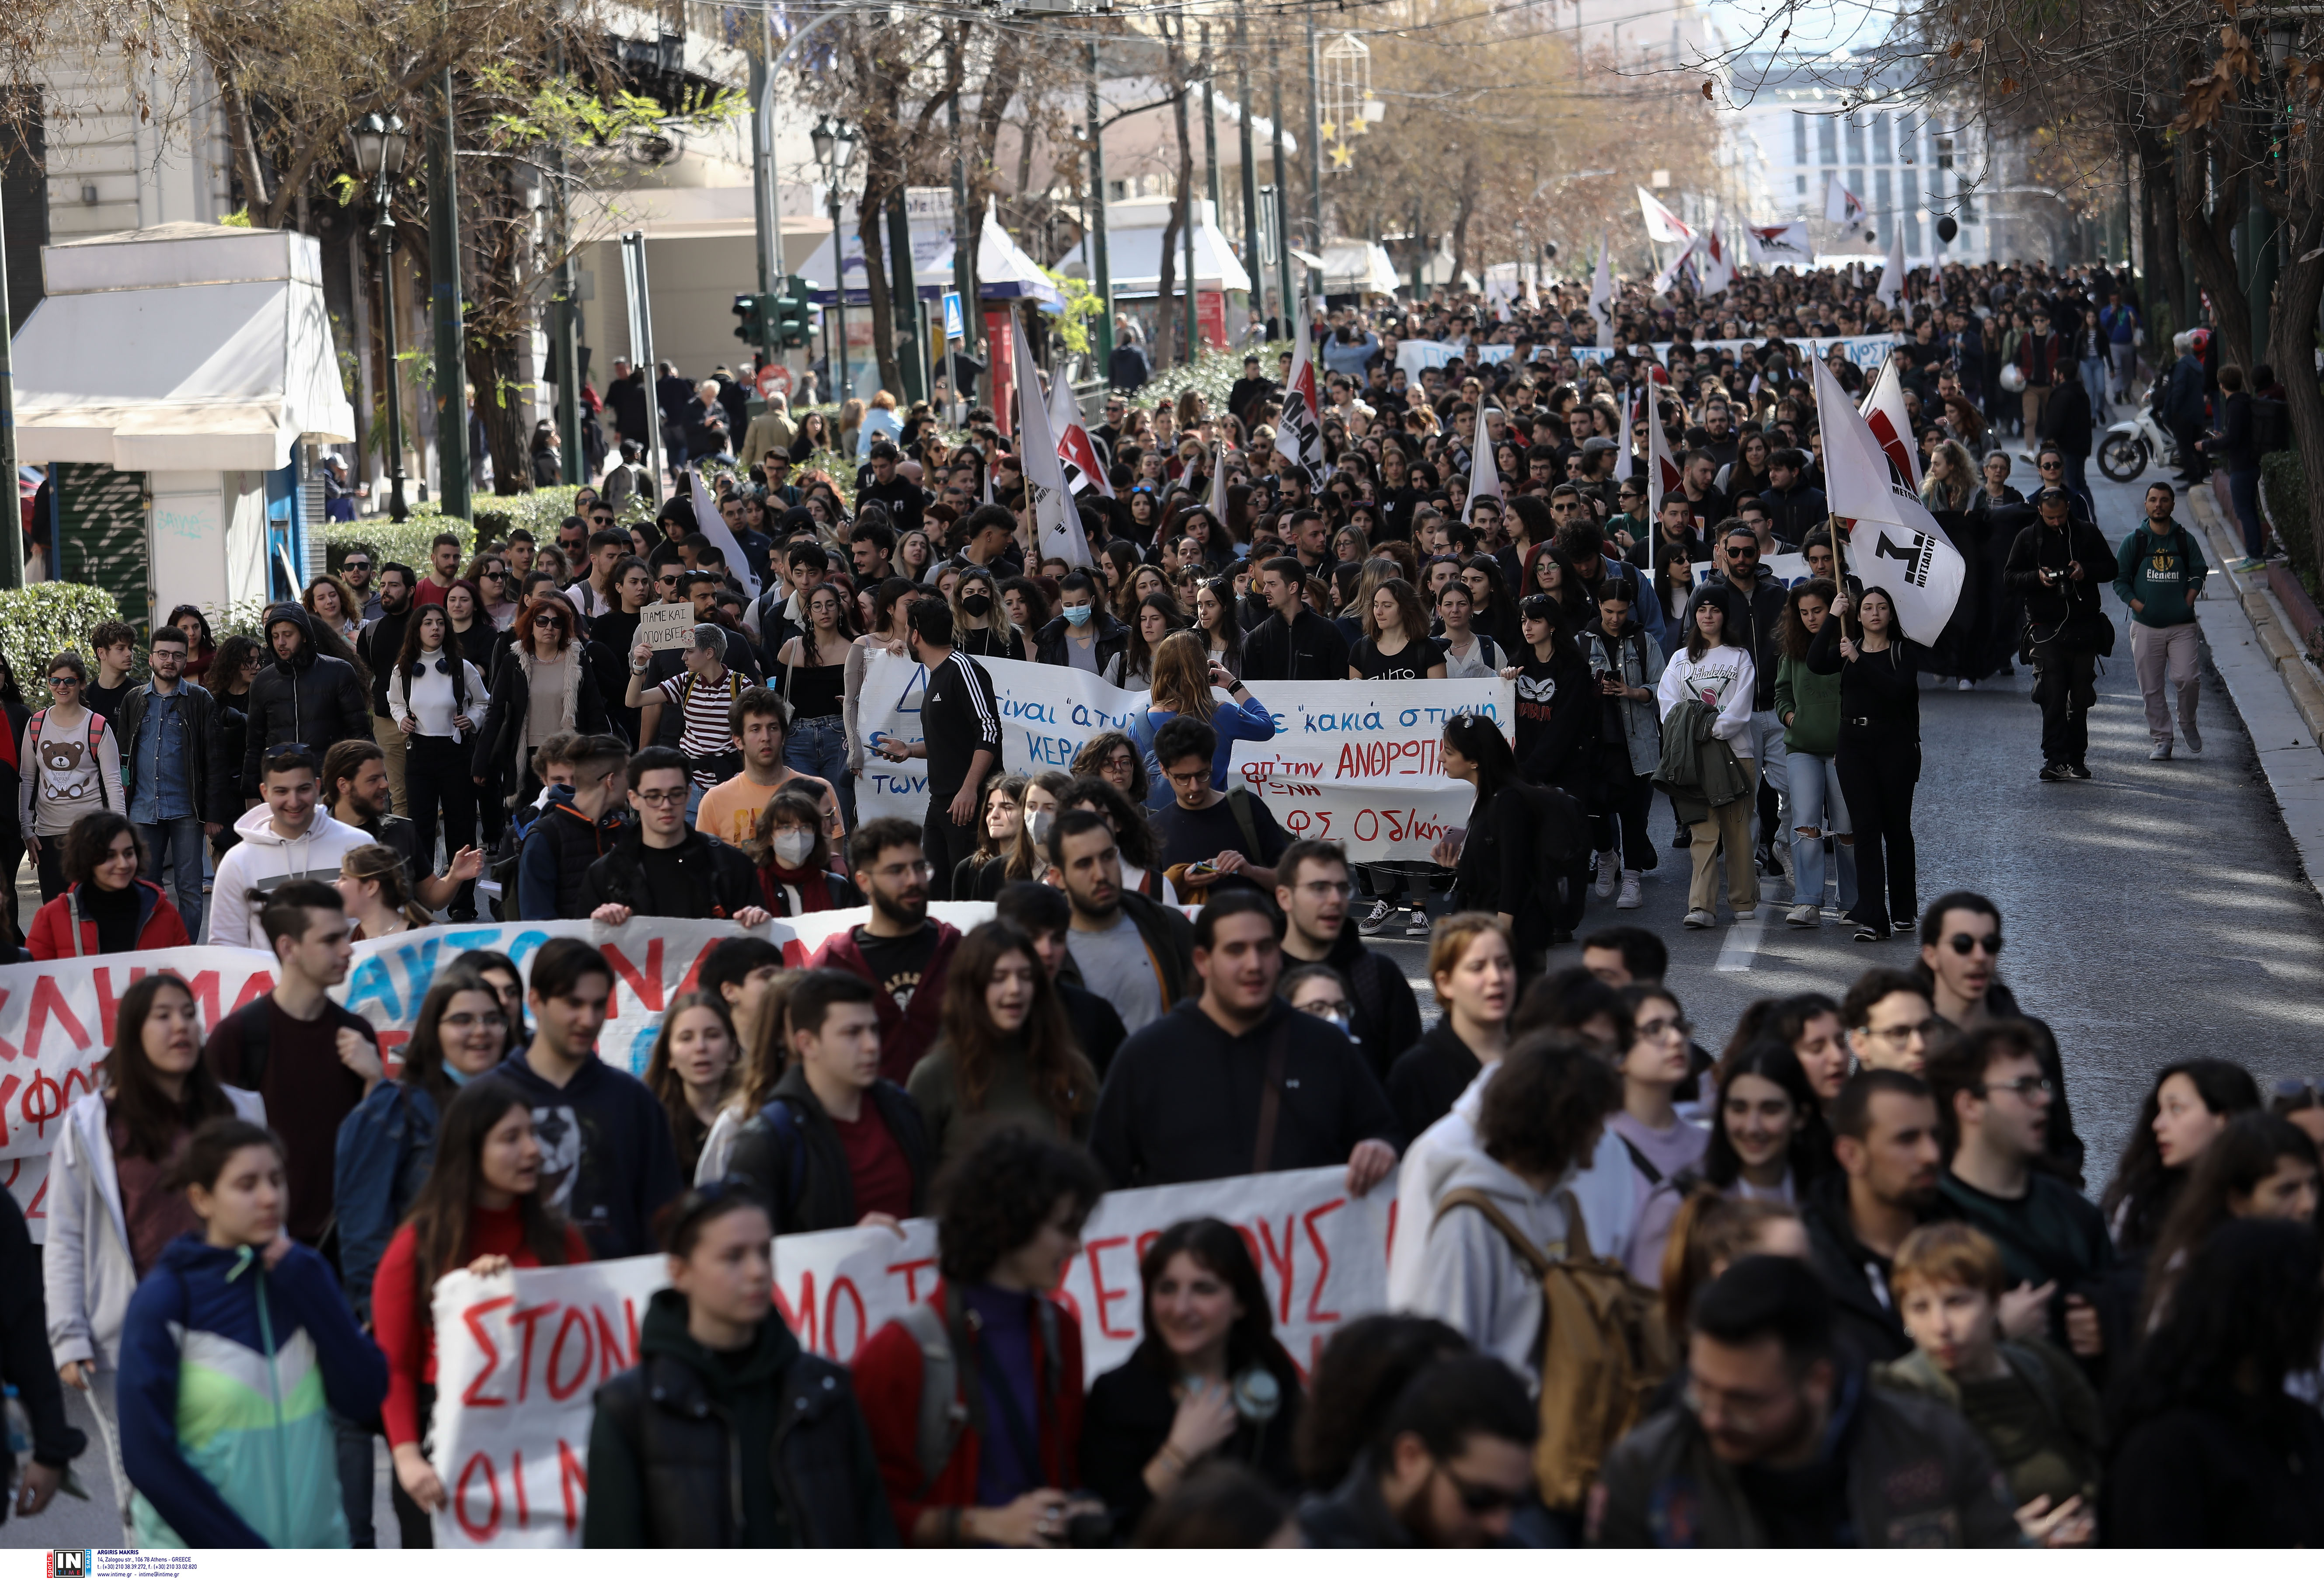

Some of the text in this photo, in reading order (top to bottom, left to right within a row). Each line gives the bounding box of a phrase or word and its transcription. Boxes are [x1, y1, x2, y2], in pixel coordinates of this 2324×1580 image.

[1892, 485, 1922, 506] ΜΕΤΩΠΟ
[2146, 569, 2179, 580] Element
[643, 609, 686, 623] ΠΑΜΕ ΚΑΙ
[643, 626, 684, 644] ΟΠΟΥ ΒΓΕΙ
[995, 689, 1057, 725] ίναι
[1354, 807, 1451, 842] Οδ/κή
[461, 1295, 641, 1408] ΣΤΟΝ
